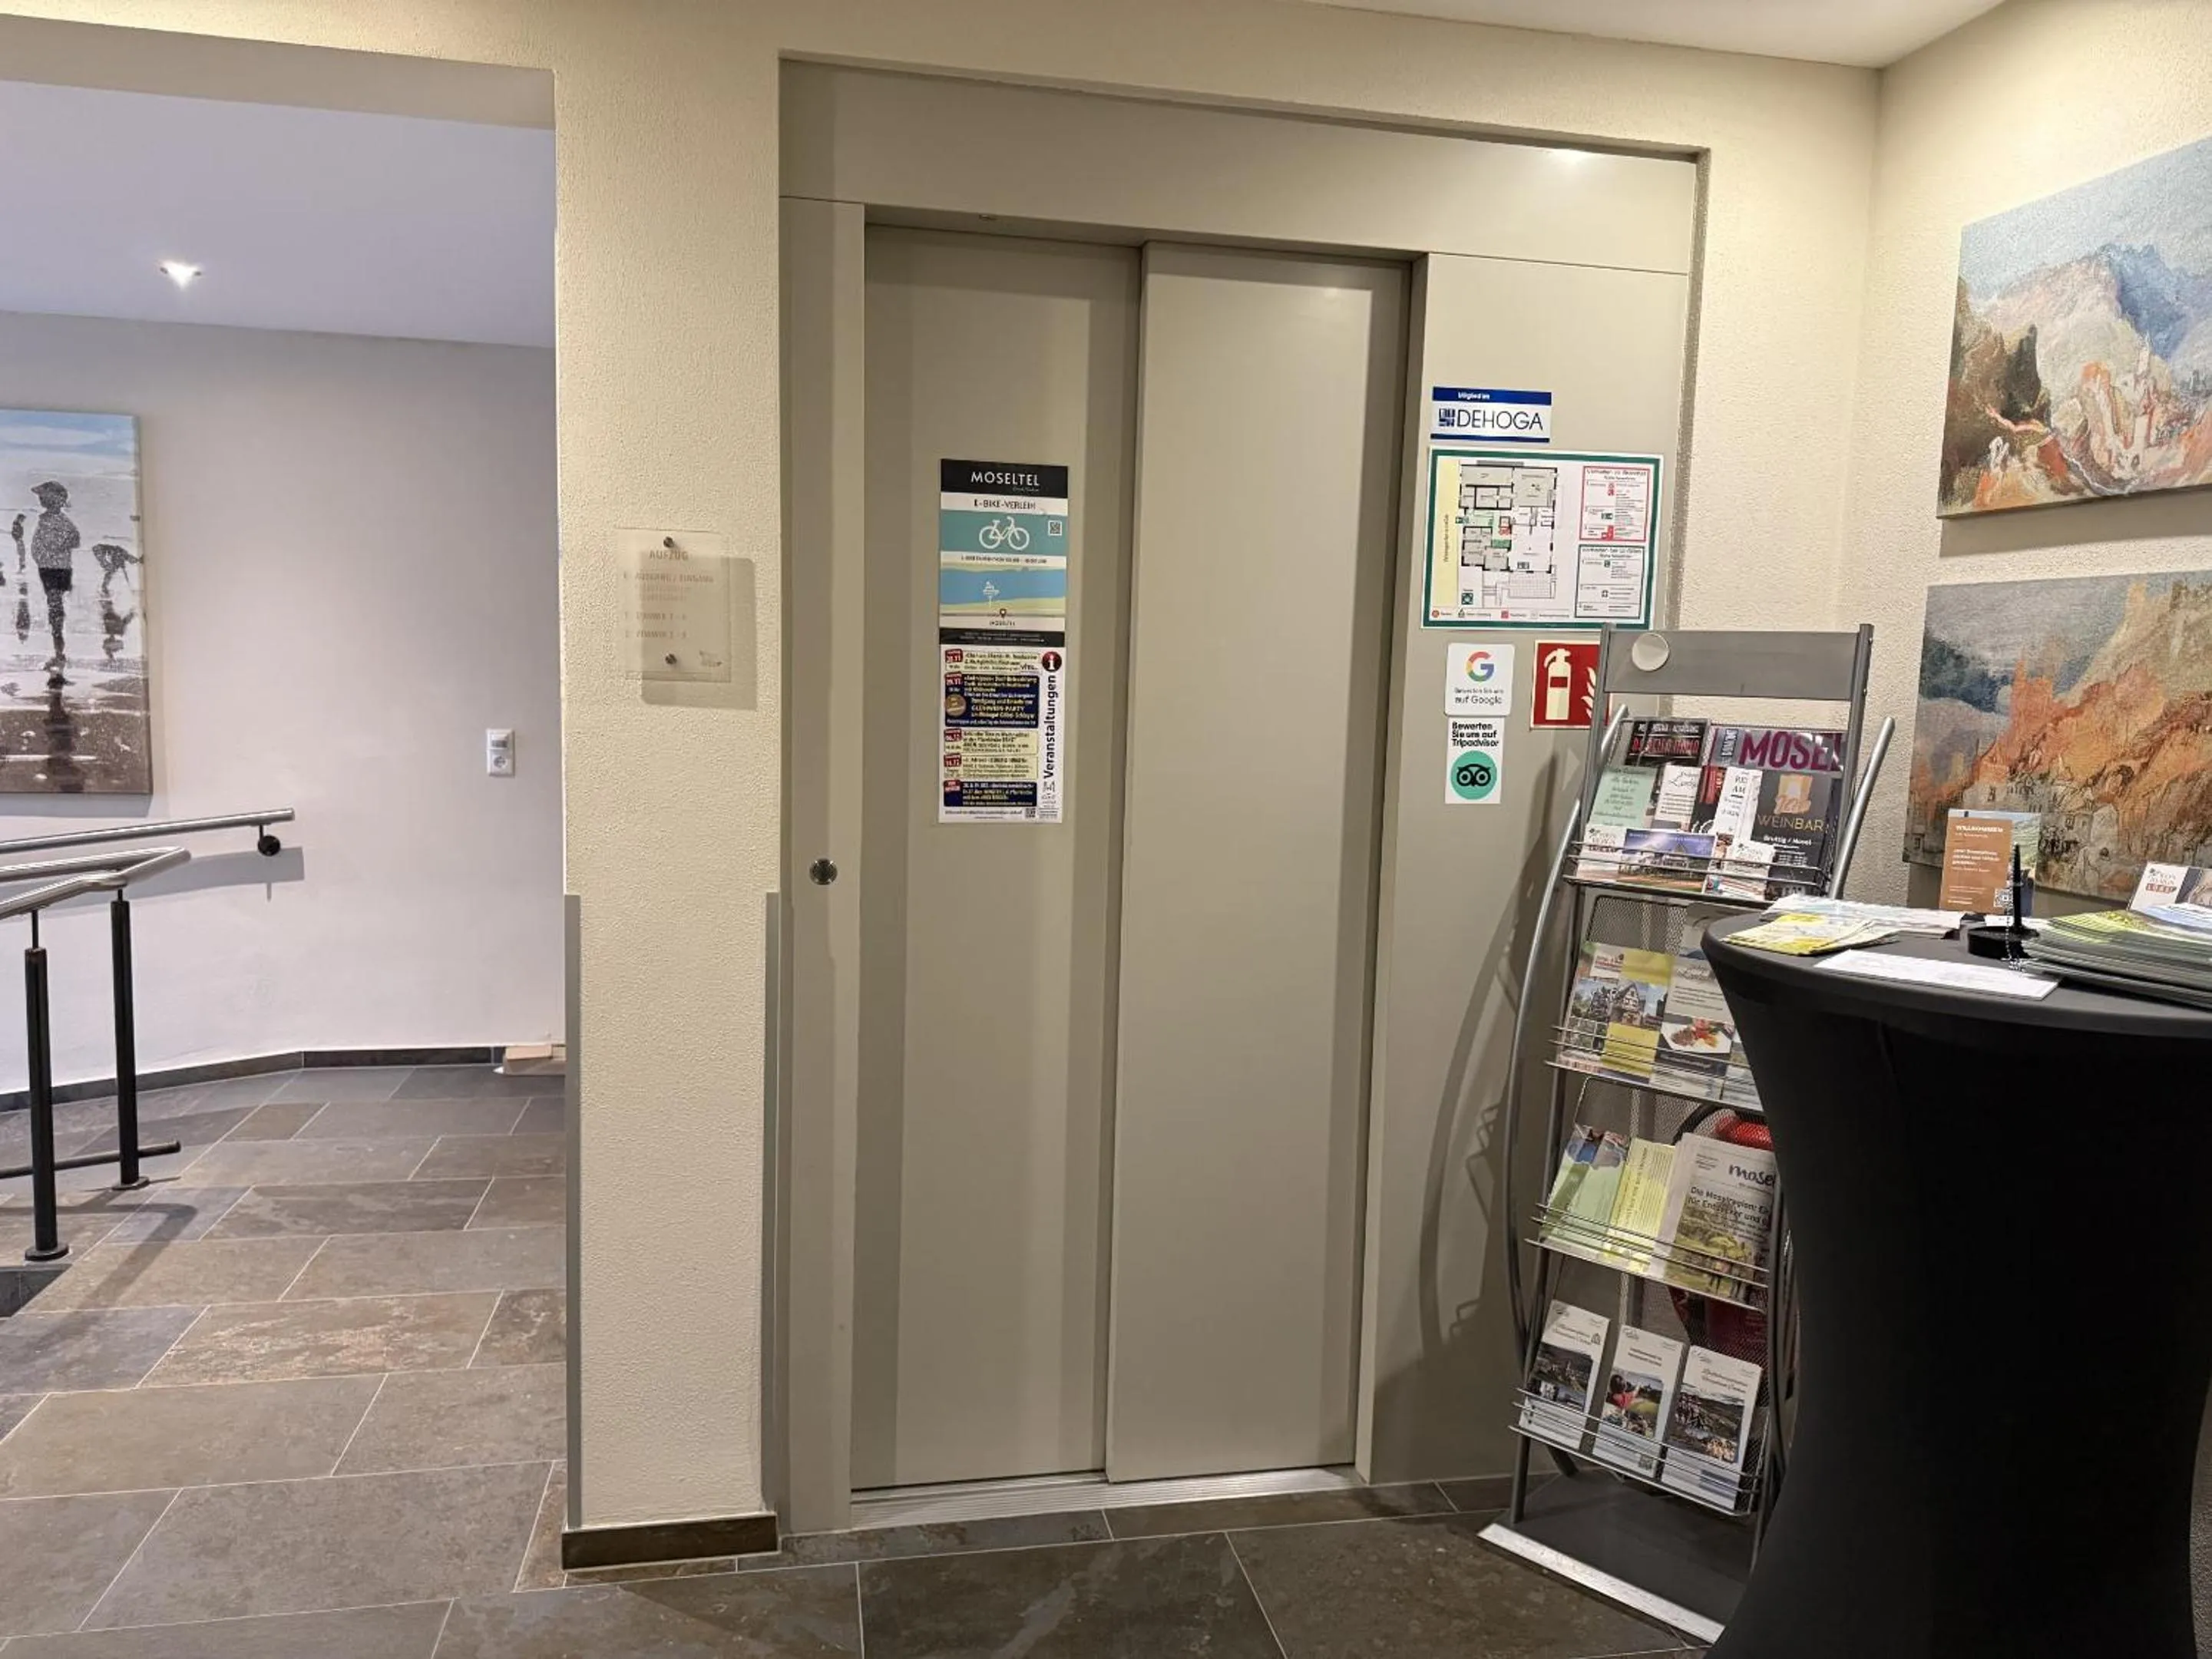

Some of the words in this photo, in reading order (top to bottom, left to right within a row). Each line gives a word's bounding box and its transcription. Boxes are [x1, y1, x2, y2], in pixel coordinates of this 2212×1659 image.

[1456, 409, 1543, 431] DEHOGA
[970, 471, 1040, 486] MOSELTEL
[1471, 696, 1503, 706] Google
[1043, 675, 1060, 779] Veranstaltungen
[1452, 722, 1493, 730] Bewerten
[1451, 739, 1499, 748] Tripadvisor
[1757, 815, 1824, 831] WEINBAR
